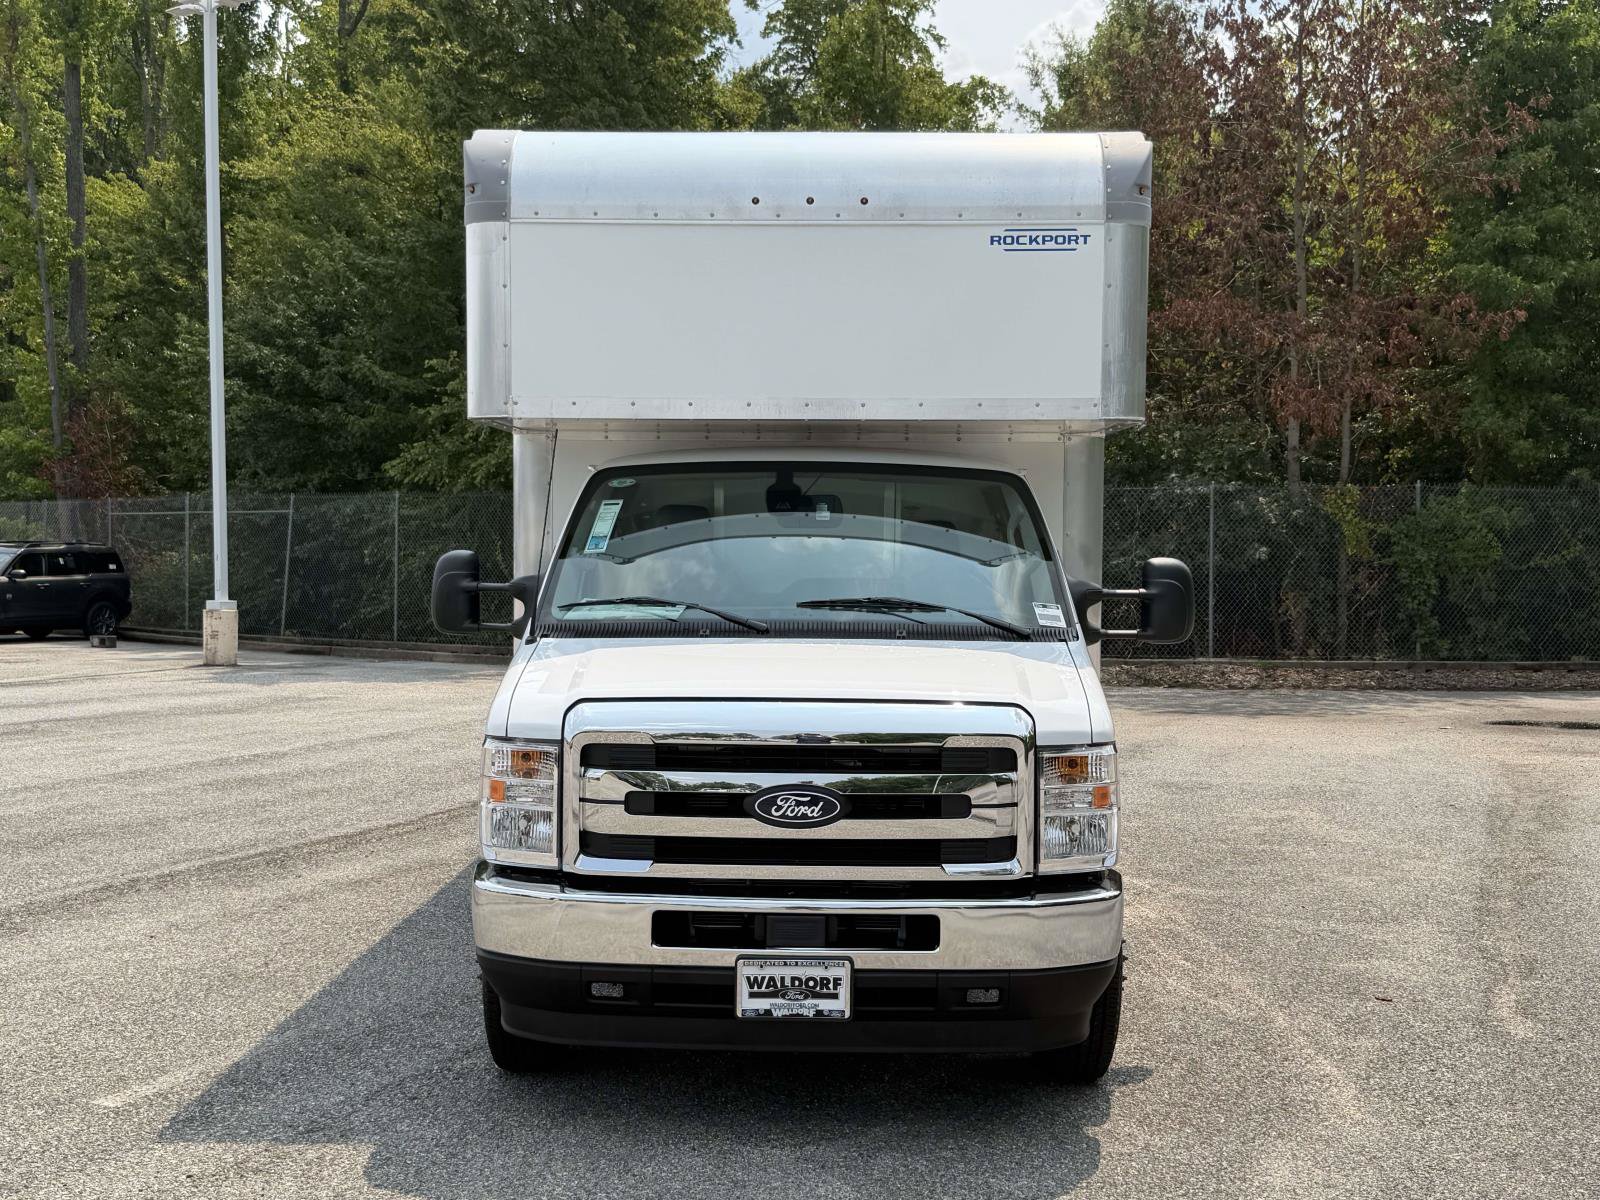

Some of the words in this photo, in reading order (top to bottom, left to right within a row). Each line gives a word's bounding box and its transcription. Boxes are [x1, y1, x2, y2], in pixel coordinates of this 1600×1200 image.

[990, 235, 1091, 245] ROCKPORT
[771, 795, 824, 817] Ford
[745, 975, 844, 991] WALDORF
[784, 991, 806, 1000] Ford
[771, 1008, 817, 1017] WALDORF
